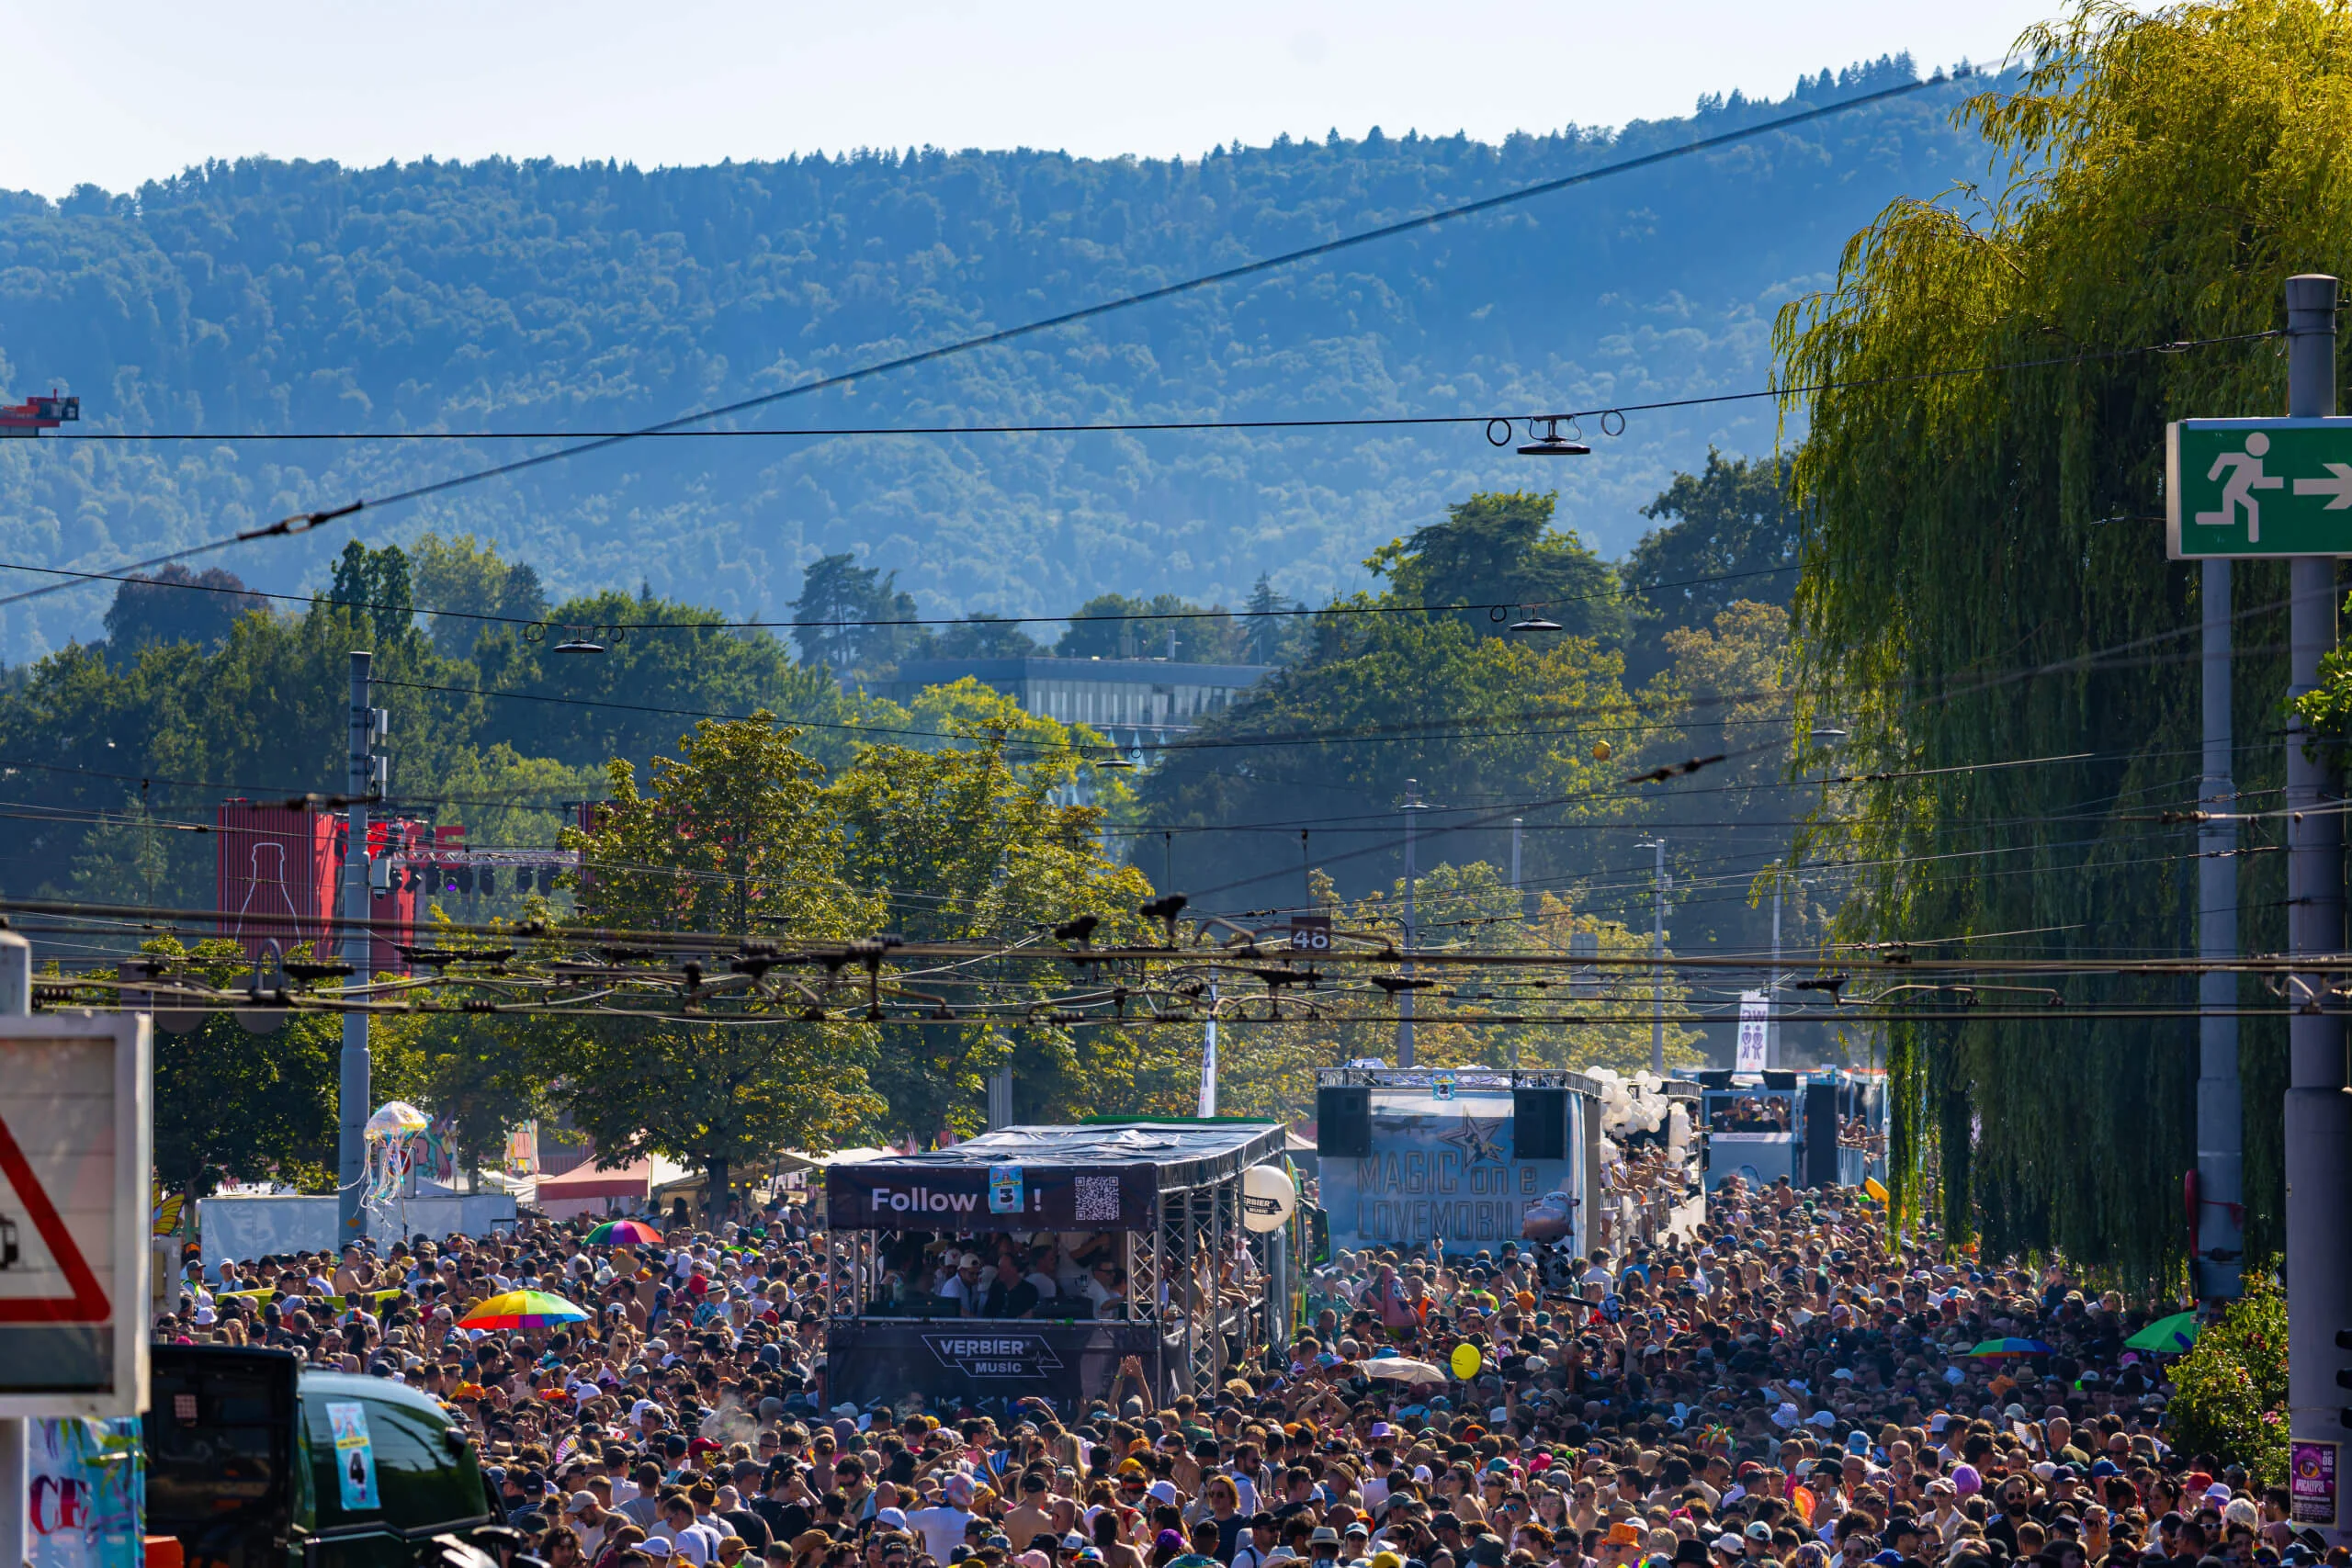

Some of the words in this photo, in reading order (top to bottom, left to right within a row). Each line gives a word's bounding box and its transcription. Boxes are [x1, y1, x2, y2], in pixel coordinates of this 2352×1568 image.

[1293, 926, 1329, 949] 48
[1439, 1084, 1449, 1094] 2
[1357, 1150, 1457, 1194] MAGIC
[872, 1187, 978, 1212] Follow
[1000, 1188, 1014, 1203] 3
[1243, 1198, 1270, 1208] ERBIER
[940, 1339, 1023, 1357] VERBIER
[975, 1362, 1022, 1373] MUSIC
[350, 1452, 365, 1484] 4
